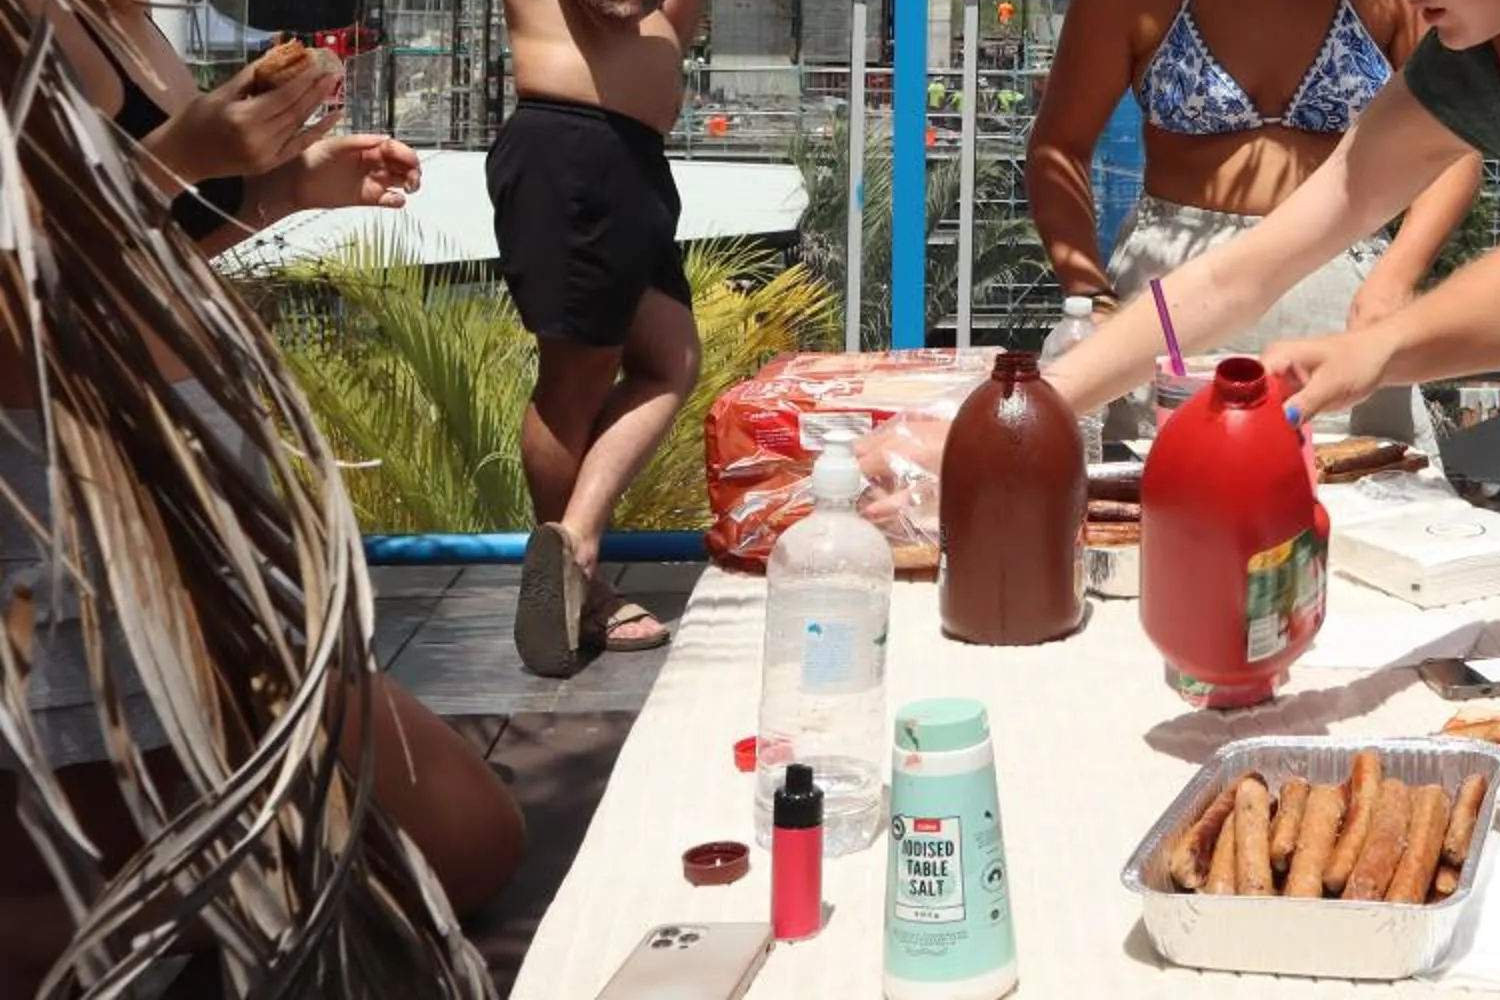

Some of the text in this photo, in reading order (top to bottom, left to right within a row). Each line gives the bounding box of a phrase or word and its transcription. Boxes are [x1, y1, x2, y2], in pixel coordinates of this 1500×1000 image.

[902, 839, 955, 857] IODISED
[906, 859, 949, 877] TABLE
[909, 879, 945, 897] SALT
